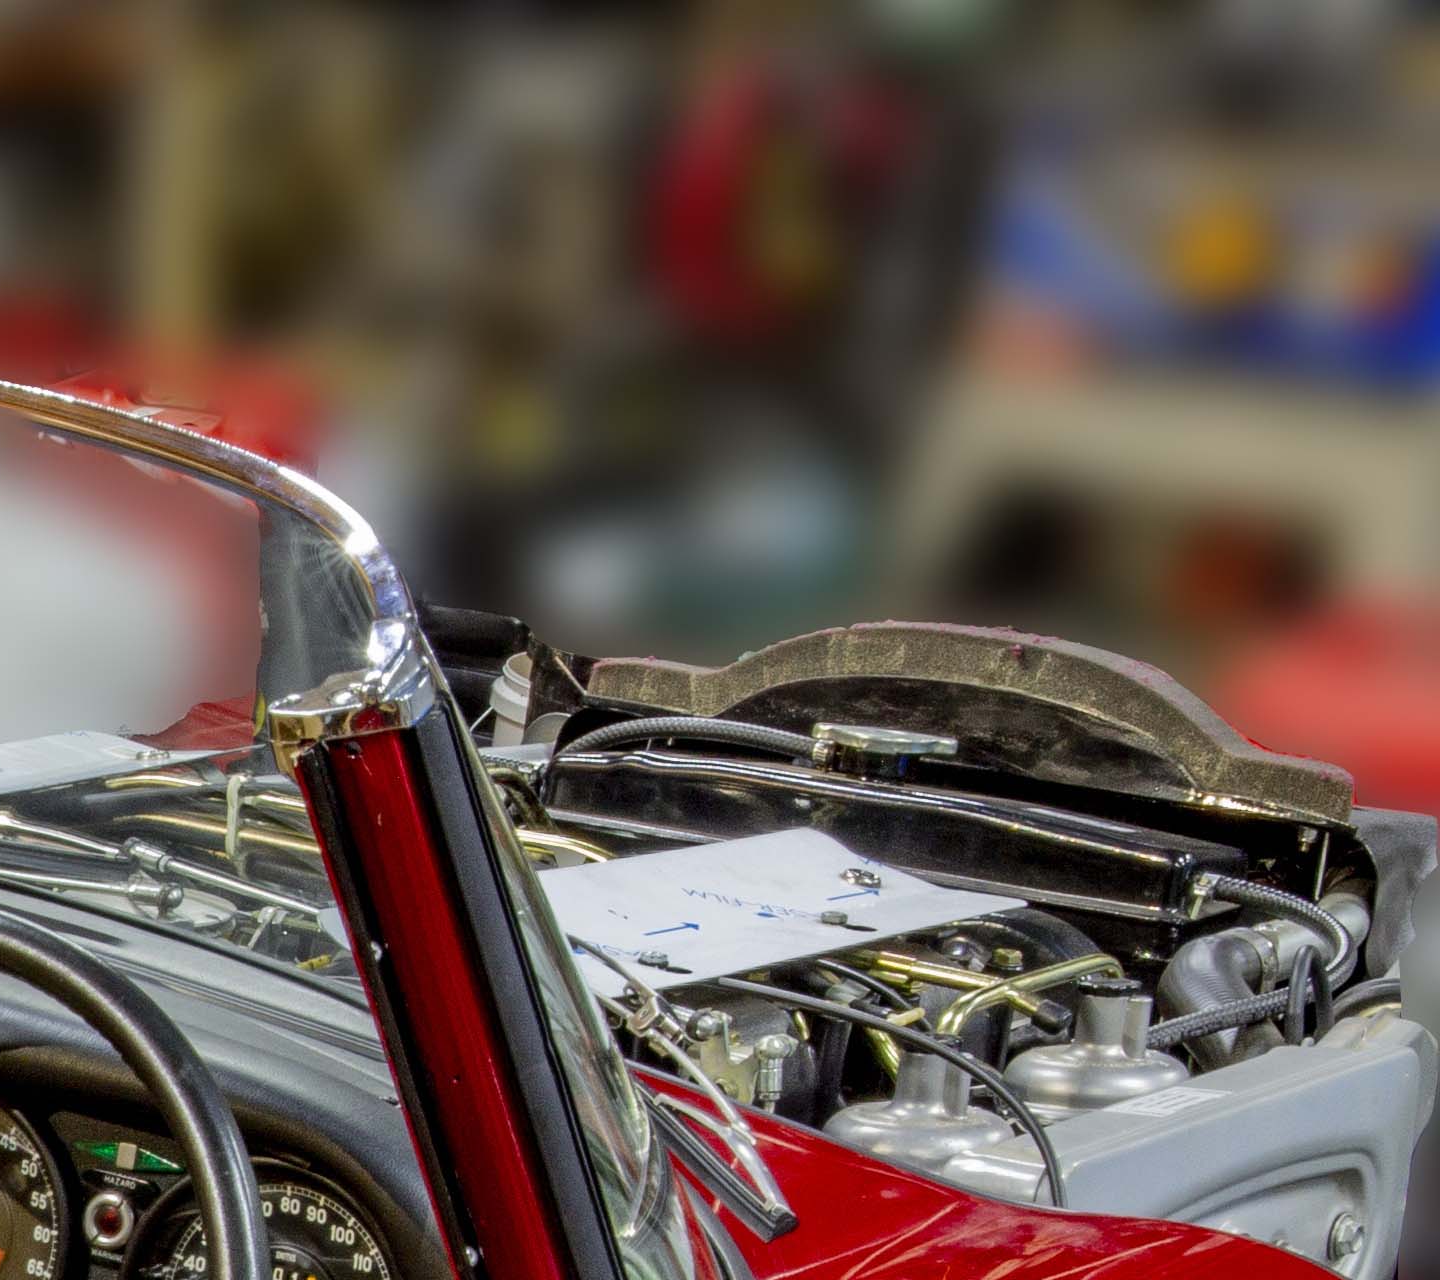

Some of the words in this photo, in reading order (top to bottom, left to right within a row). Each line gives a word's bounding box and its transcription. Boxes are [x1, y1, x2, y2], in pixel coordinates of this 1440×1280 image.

[0, 1135, 17, 1151] 45
[20, 1159, 38, 1178] 50
[104, 1175, 136, 1190] HAZARD
[30, 1191, 48, 1210] 55
[280, 1196, 301, 1215] 80
[306, 1205, 327, 1225] 90
[33, 1224, 51, 1243] 60
[330, 1225, 355, 1245] 100
[27, 1258, 45, 1277] 65
[183, 1255, 206, 1272] 40
[353, 1253, 373, 1273] 110
